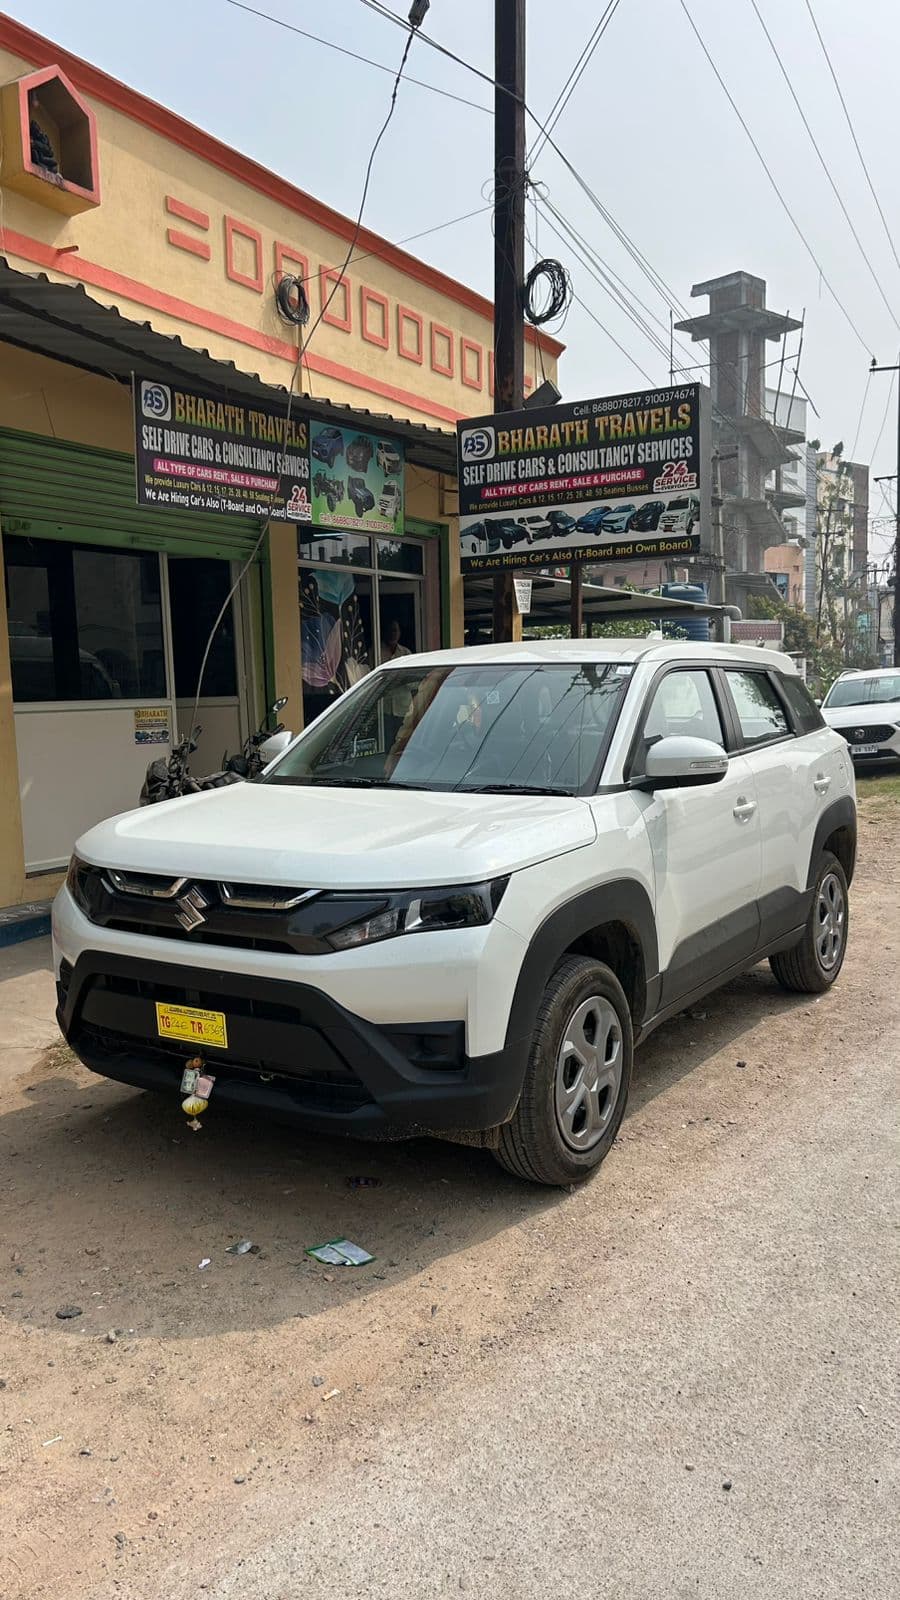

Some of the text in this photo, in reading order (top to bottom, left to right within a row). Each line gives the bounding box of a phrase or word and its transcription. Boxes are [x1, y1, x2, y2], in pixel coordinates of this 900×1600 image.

[573, 405, 590, 416] Cell:
[645, 388, 695, 406] 9100374674
[174, 391, 307, 449] BHARATH TRAVELS
[497, 403, 691, 456] BHARATH TRAVELS
[142, 425, 309, 479] SELF DRIVE CARS & CONSULTANCY SERVICES
[463, 436, 693, 486] SELF DRIVE CARS & CONSULTANCY SERVICES
[145, 474, 153, 485] We
[154, 475, 172, 488] provide
[173, 478, 190, 492] Luxury
[191, 480, 201, 492] Cars
[157, 461, 169, 472] ALL
[170, 463, 186, 475] TYPE
[187, 466, 196, 476] OF
[197, 467, 212, 479] CARS
[231, 473, 244, 485] SALE
[246, 475, 250, 486] &
[655, 474, 695, 487] SERVICE
[663, 462, 687, 478] 24
[292, 486, 307, 503] 24
[484, 488, 498, 498] ALL
[499, 485, 517, 495] TYPE
[518, 483, 528, 492] OF
[529, 481, 548, 491] CARS
[573, 477, 591, 487] SALE
[593, 476, 599, 484] &
[601, 470, 642, 483] PURCHASE
[145, 487, 156, 500] We
[157, 489, 169, 502] Are
[171, 491, 189, 506] Hiring
[191, 494, 206, 507] Car's
[206, 496, 219, 509] Also
[221, 498, 244, 513] (T-Board
[245, 503, 255, 514] and
[256, 504, 268, 515] Own
[289, 501, 311, 514] SERVICE
[499, 498, 518, 508] Luxury
[470, 539, 692, 568] We Are Hiring Car's Also (T-Board and Own Board)
[161, 1015, 171, 1028] TG
